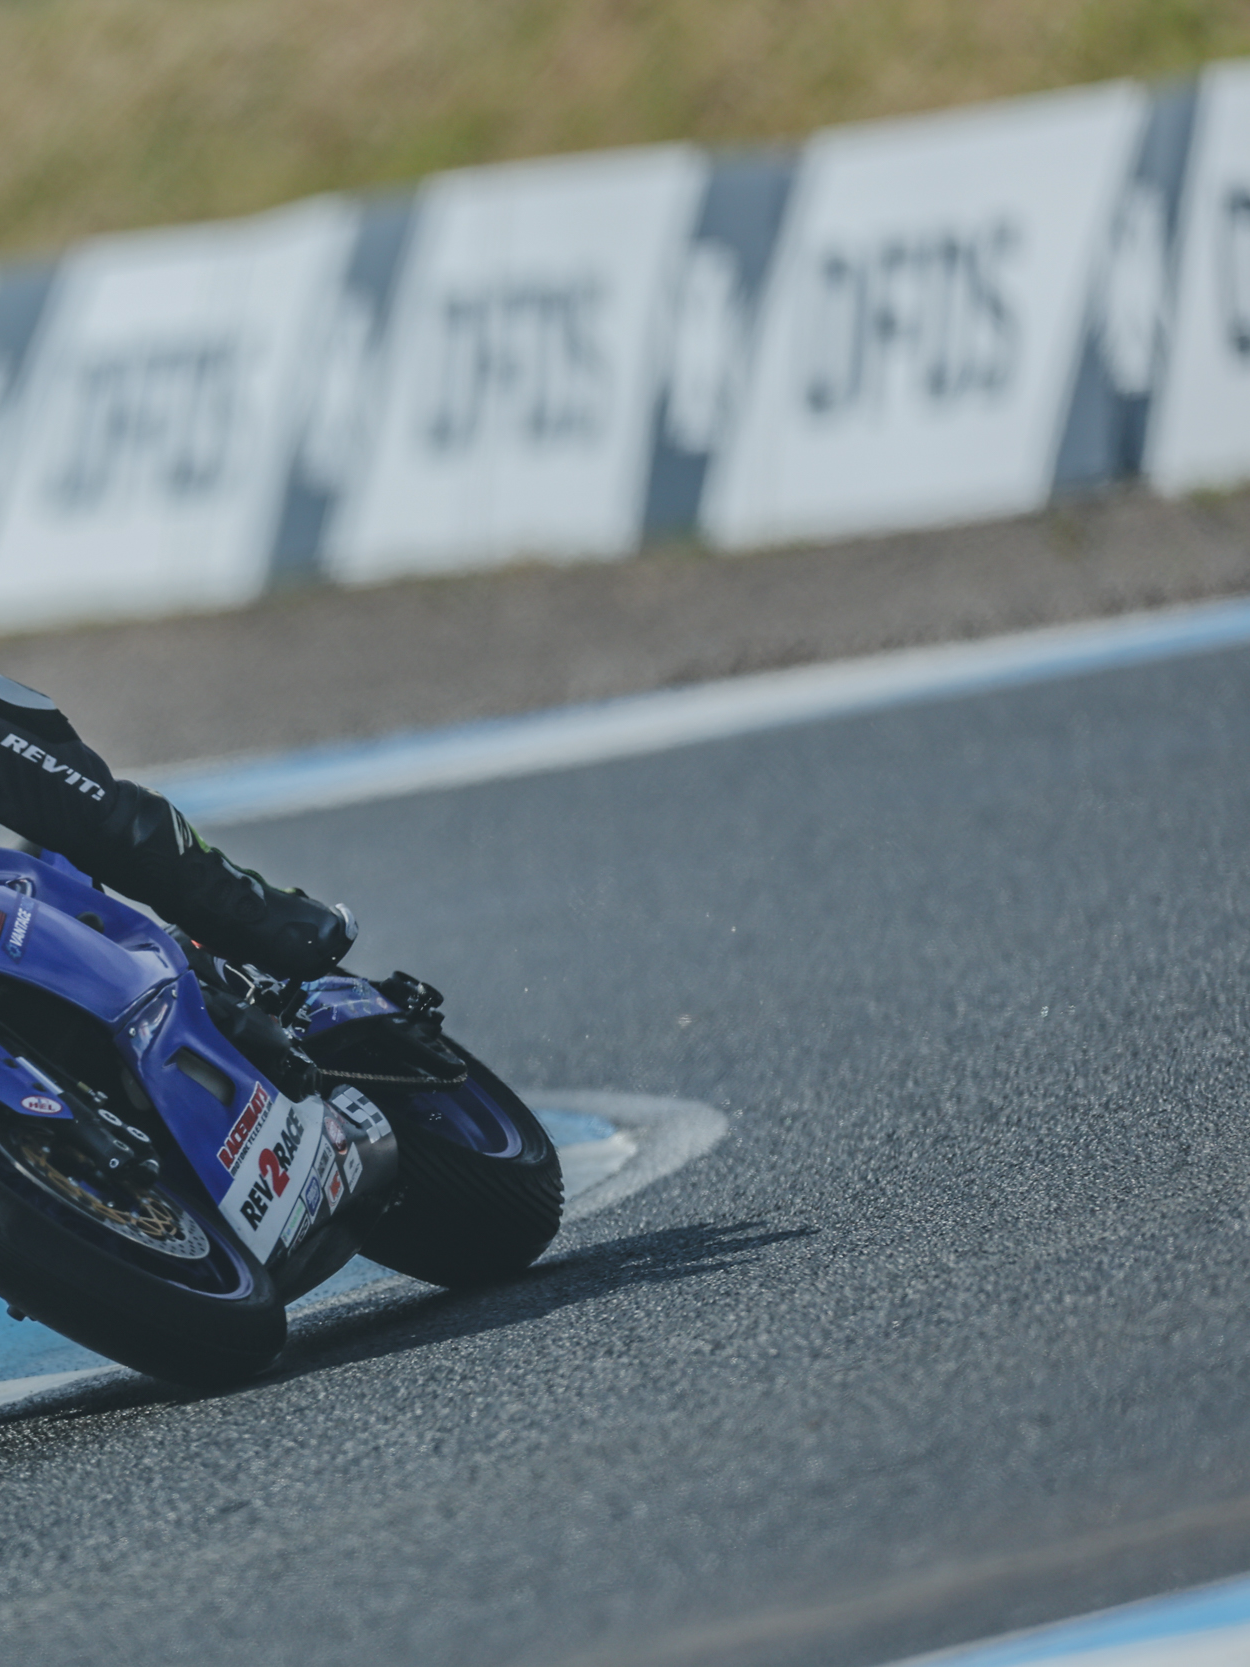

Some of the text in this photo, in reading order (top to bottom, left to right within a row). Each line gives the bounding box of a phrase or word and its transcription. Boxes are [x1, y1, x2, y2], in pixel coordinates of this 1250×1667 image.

[0, 733, 105, 801] REV'IT!
[9, 908, 31, 946] VANTAGE
[28, 1102, 55, 1111] HEL
[217, 1082, 270, 1171] RACEWAYS
[240, 1107, 304, 1231] REV2RACE
